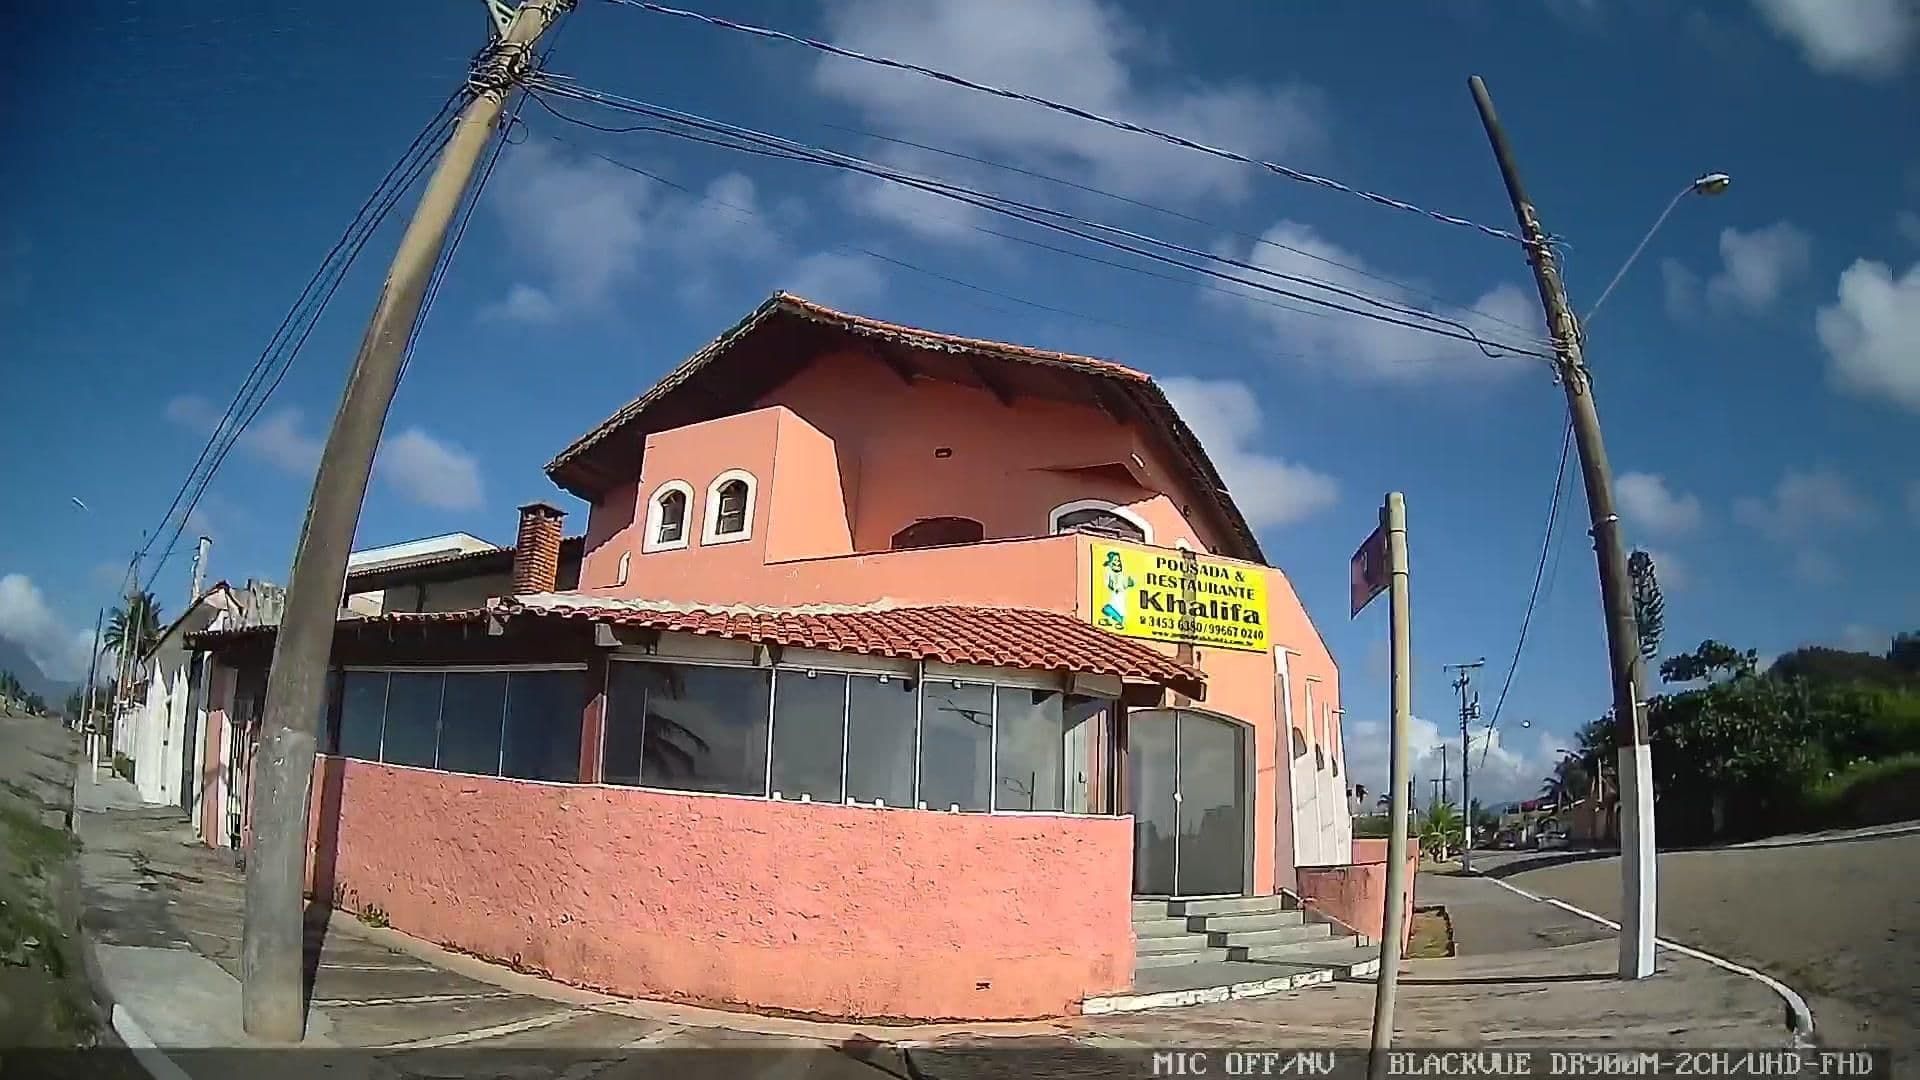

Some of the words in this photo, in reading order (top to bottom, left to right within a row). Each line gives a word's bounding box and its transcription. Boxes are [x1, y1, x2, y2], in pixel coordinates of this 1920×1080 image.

[1156, 557, 1230, 580] POUSADA
[1234, 570, 1246, 583] &
[1146, 573, 1256, 600] RESTAURANTE
[1139, 589, 1262, 626] Khalifa
[1148, 615, 1175, 629] 3453
[1240, 628, 1265, 641] 0240
